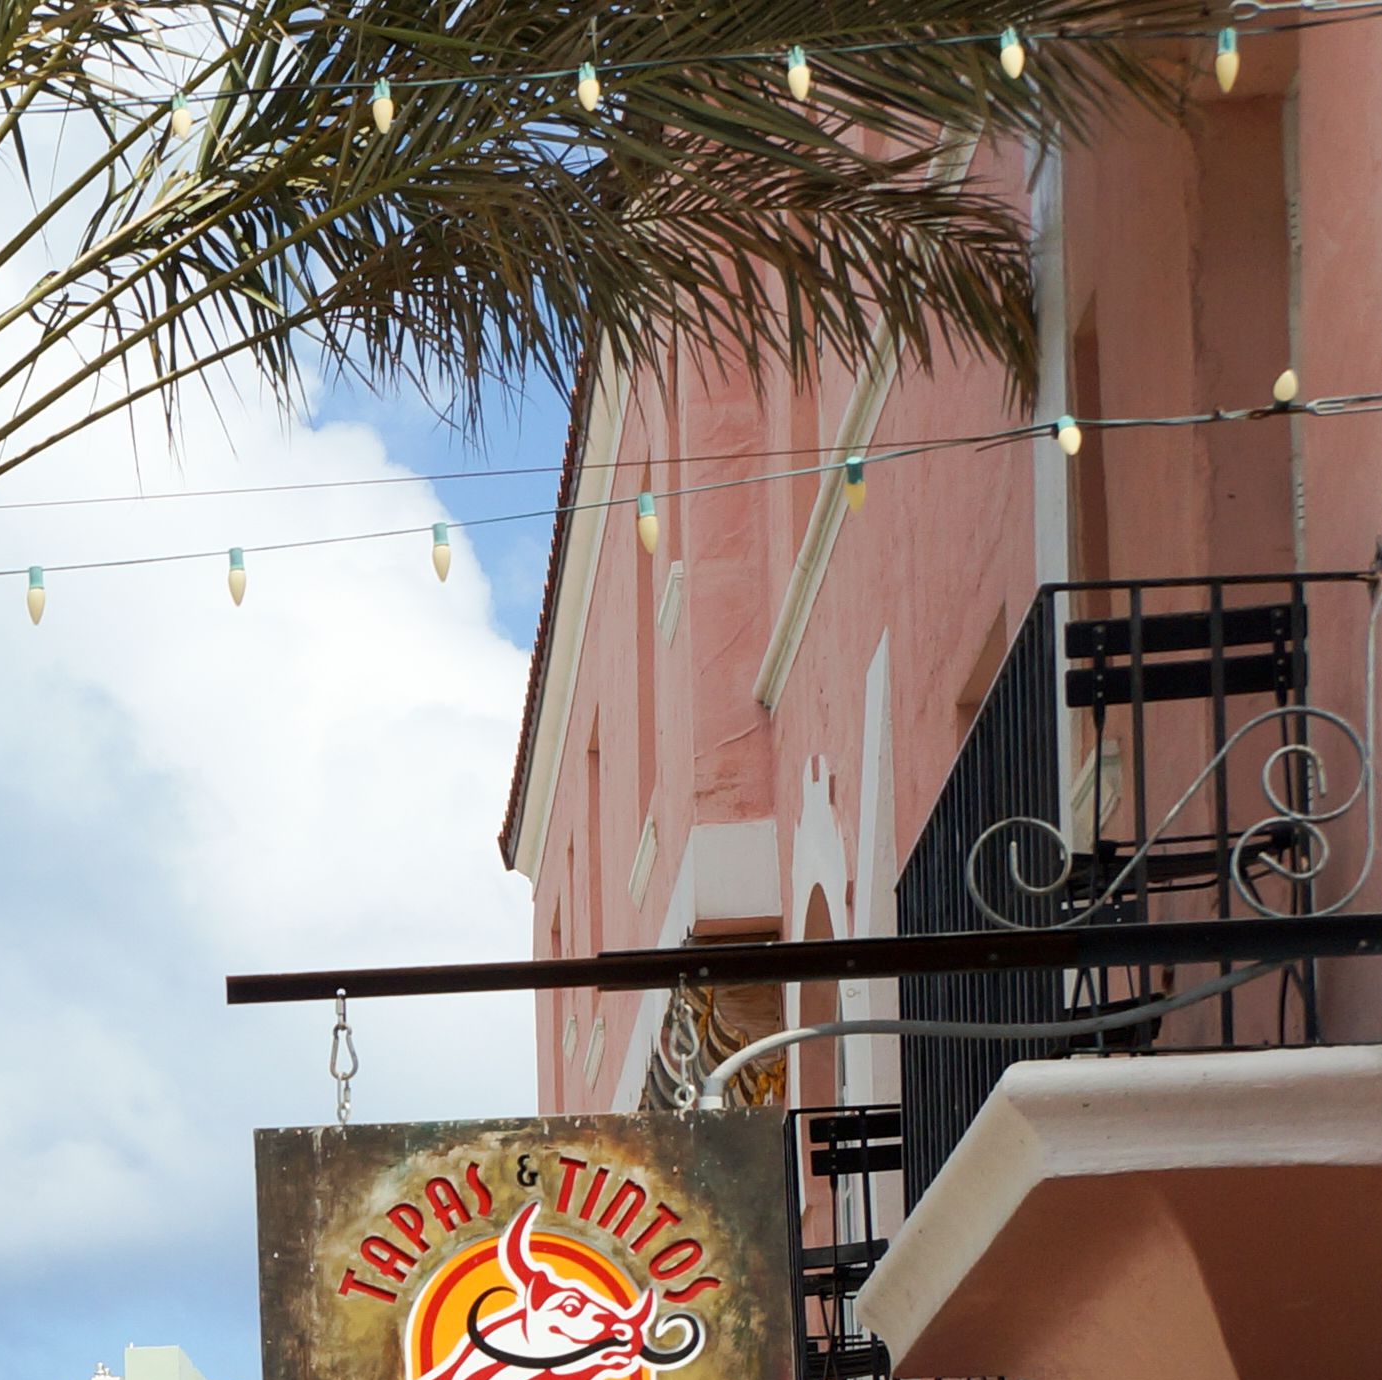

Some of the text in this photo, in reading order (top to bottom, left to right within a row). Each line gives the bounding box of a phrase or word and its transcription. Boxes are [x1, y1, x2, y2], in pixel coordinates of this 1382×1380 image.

[338, 1153, 722, 1305] TAPAS & TINTOS
